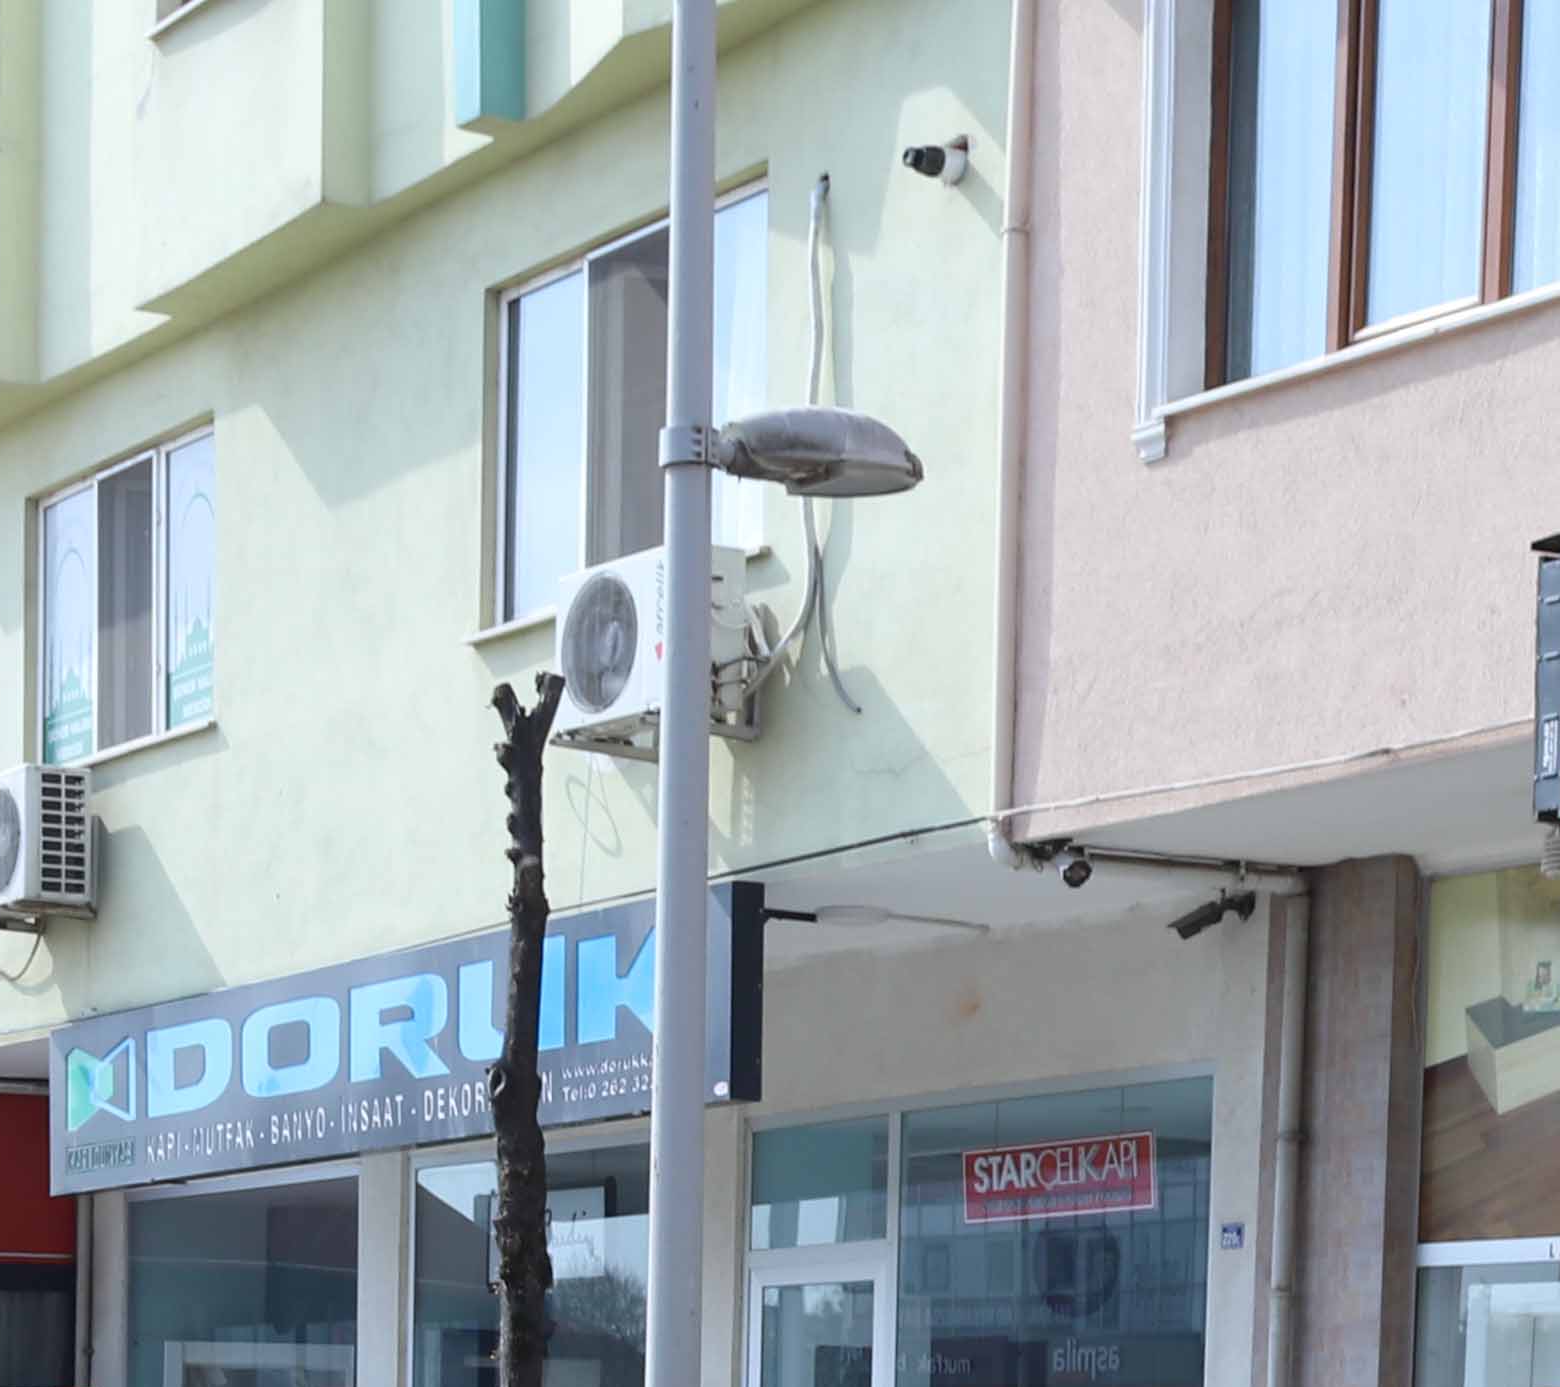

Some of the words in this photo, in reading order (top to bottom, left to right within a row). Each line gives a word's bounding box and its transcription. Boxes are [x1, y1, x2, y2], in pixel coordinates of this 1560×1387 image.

[145, 926, 655, 1118] DORUK
[146, 1131, 181, 1163] KAPI
[193, 1120, 255, 1157] MUTFAK
[271, 1107, 326, 1145] BANYO
